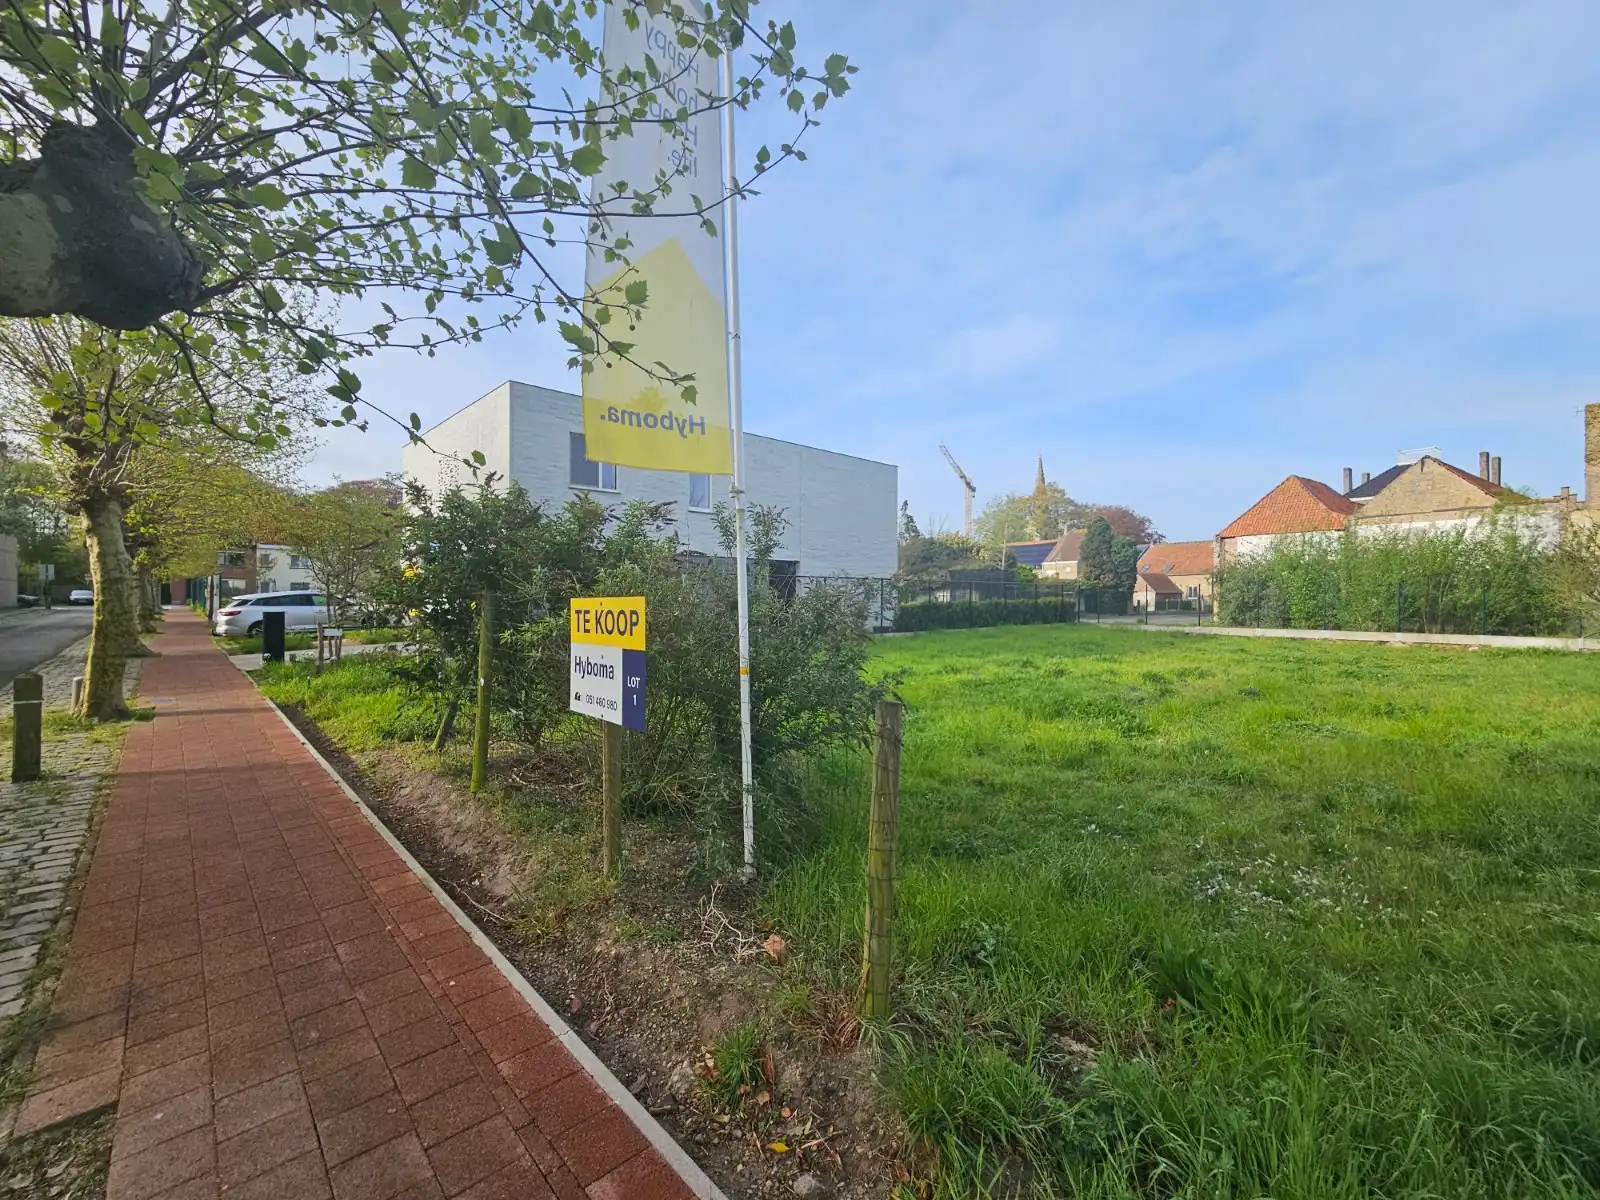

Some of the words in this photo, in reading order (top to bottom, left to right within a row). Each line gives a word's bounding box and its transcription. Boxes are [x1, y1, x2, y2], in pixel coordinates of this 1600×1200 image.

[574, 609, 591, 634] TE
[595, 609, 640, 636] KOOP
[574, 655, 615, 680] Hyboma
[627, 676, 640, 688] LOT
[585, 694, 595, 705] 051
[606, 699, 618, 711] 980
[632, 694, 638, 706] 1
